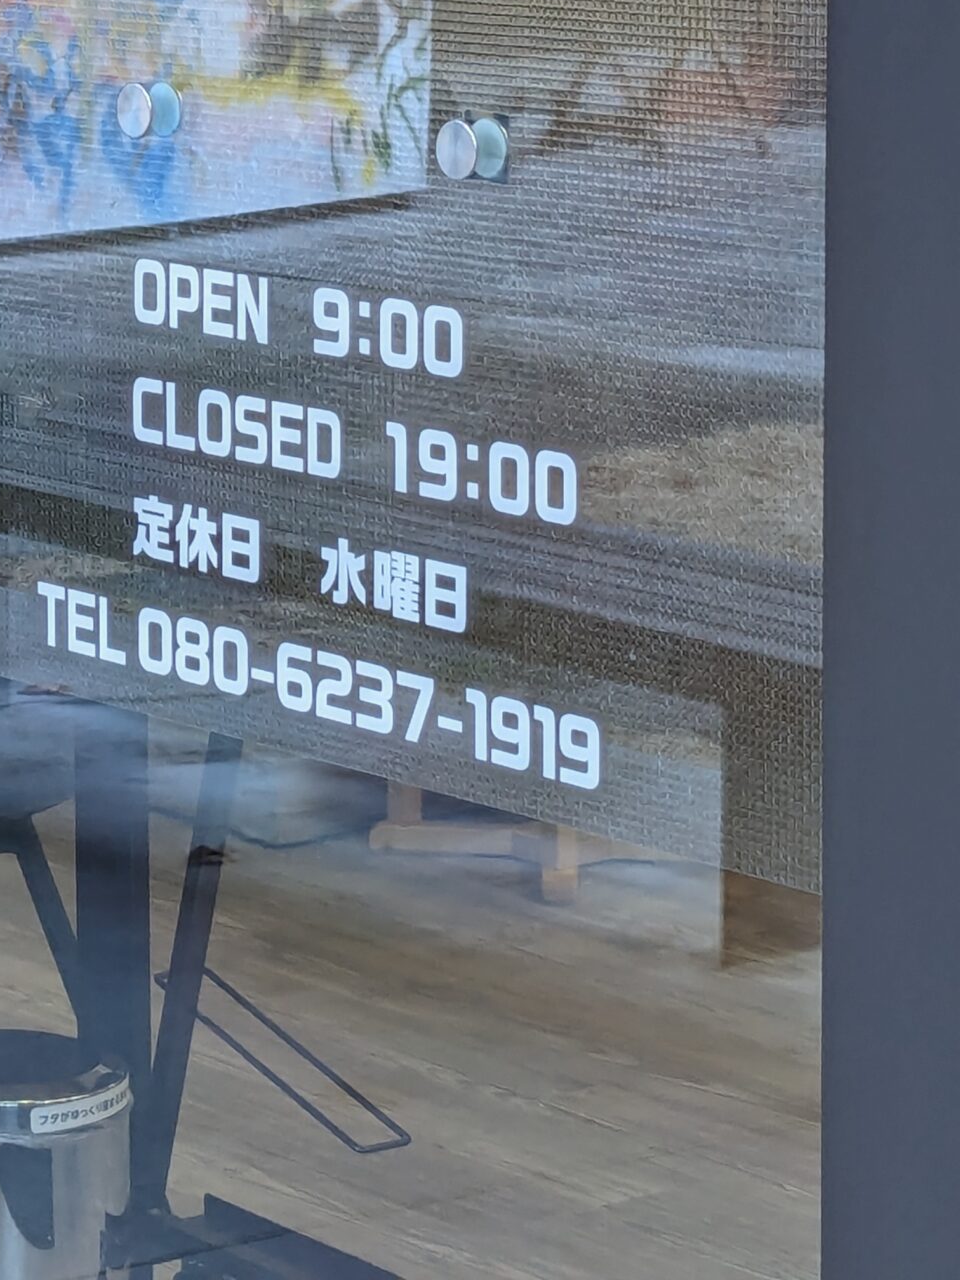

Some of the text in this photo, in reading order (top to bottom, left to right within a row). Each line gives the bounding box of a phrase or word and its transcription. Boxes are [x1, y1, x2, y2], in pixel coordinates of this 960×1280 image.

[133, 258, 464, 378] OPEN 9:00
[132, 376, 578, 526] CLOSED 19:00
[132, 494, 468, 634] 定休日 水曜日
[37, 580, 601, 791] TEL 080-6237-1919
